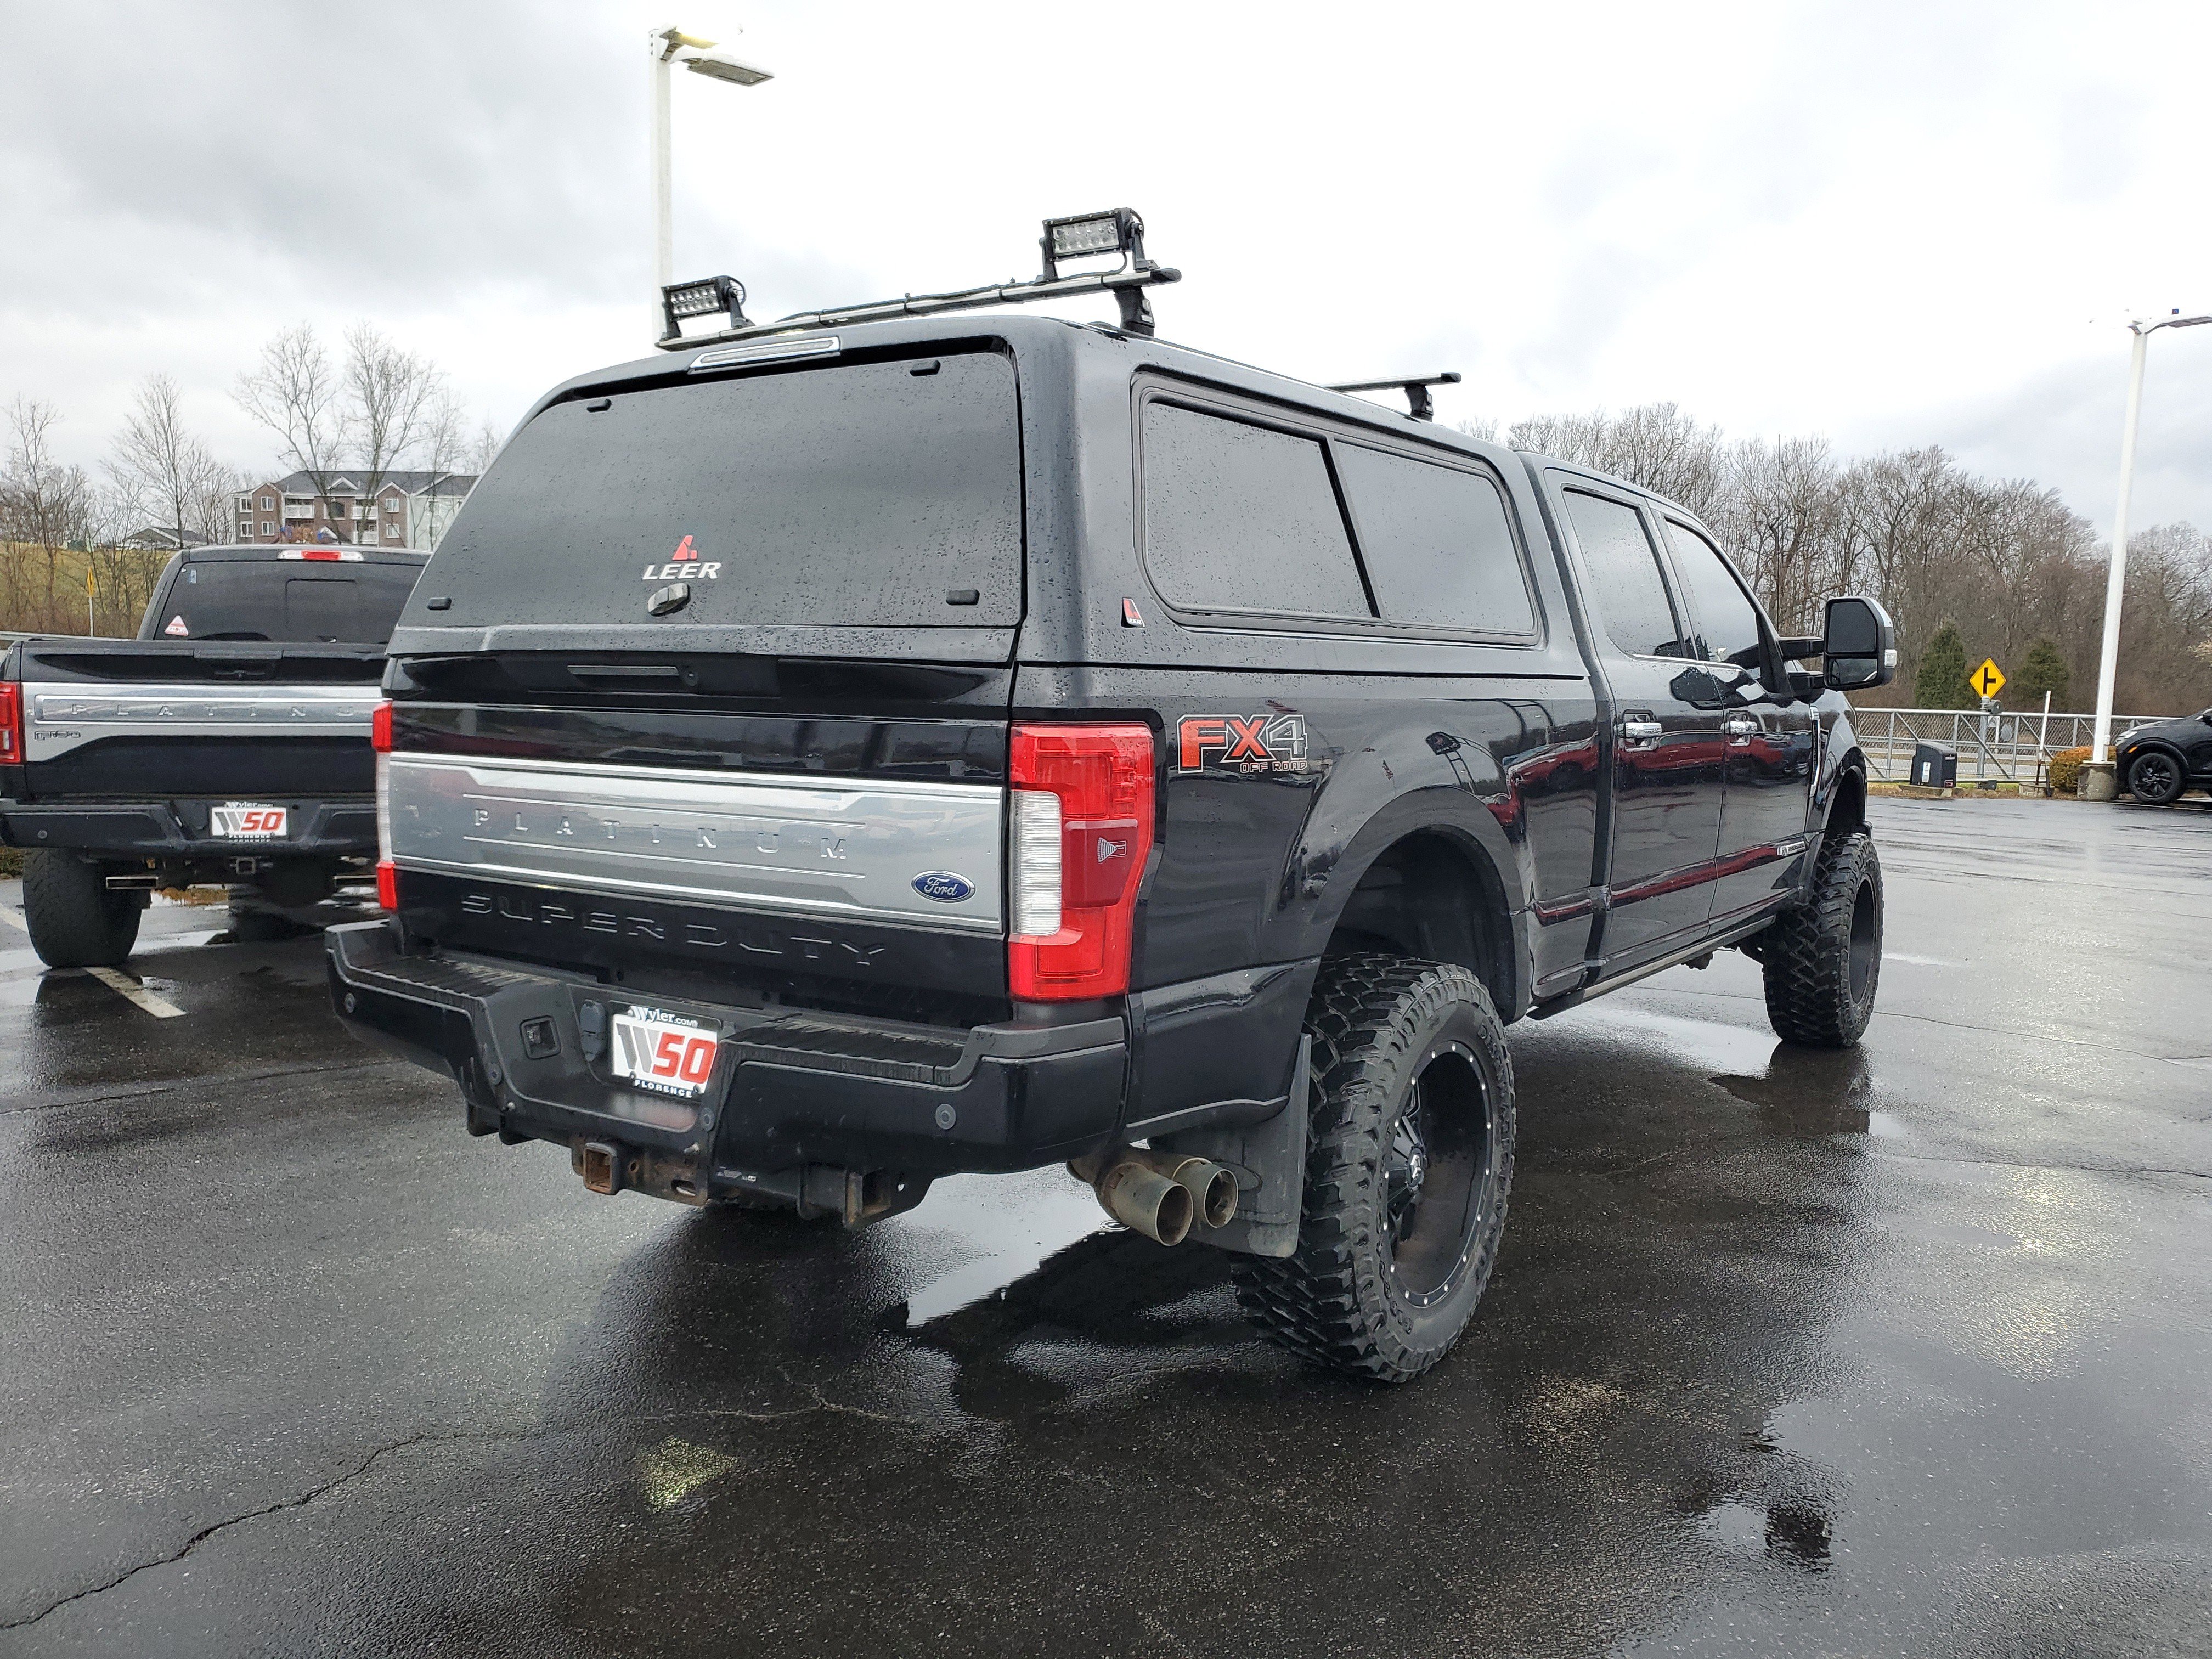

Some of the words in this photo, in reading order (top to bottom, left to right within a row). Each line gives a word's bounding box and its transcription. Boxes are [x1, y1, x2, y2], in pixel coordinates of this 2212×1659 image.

[642, 562, 722, 580] LEER
[71, 704, 354, 716] PLATINU
[1177, 714, 1308, 774] FX4
[1239, 763, 1268, 774] OFF
[1272, 760, 1308, 772] ROAD
[474, 809, 847, 860] PLATINUM
[923, 877, 958, 896] Ford
[461, 895, 665, 939] SUPER
[685, 924, 885, 966] DUTY
[634, 1079, 692, 1098] FLORENCE
